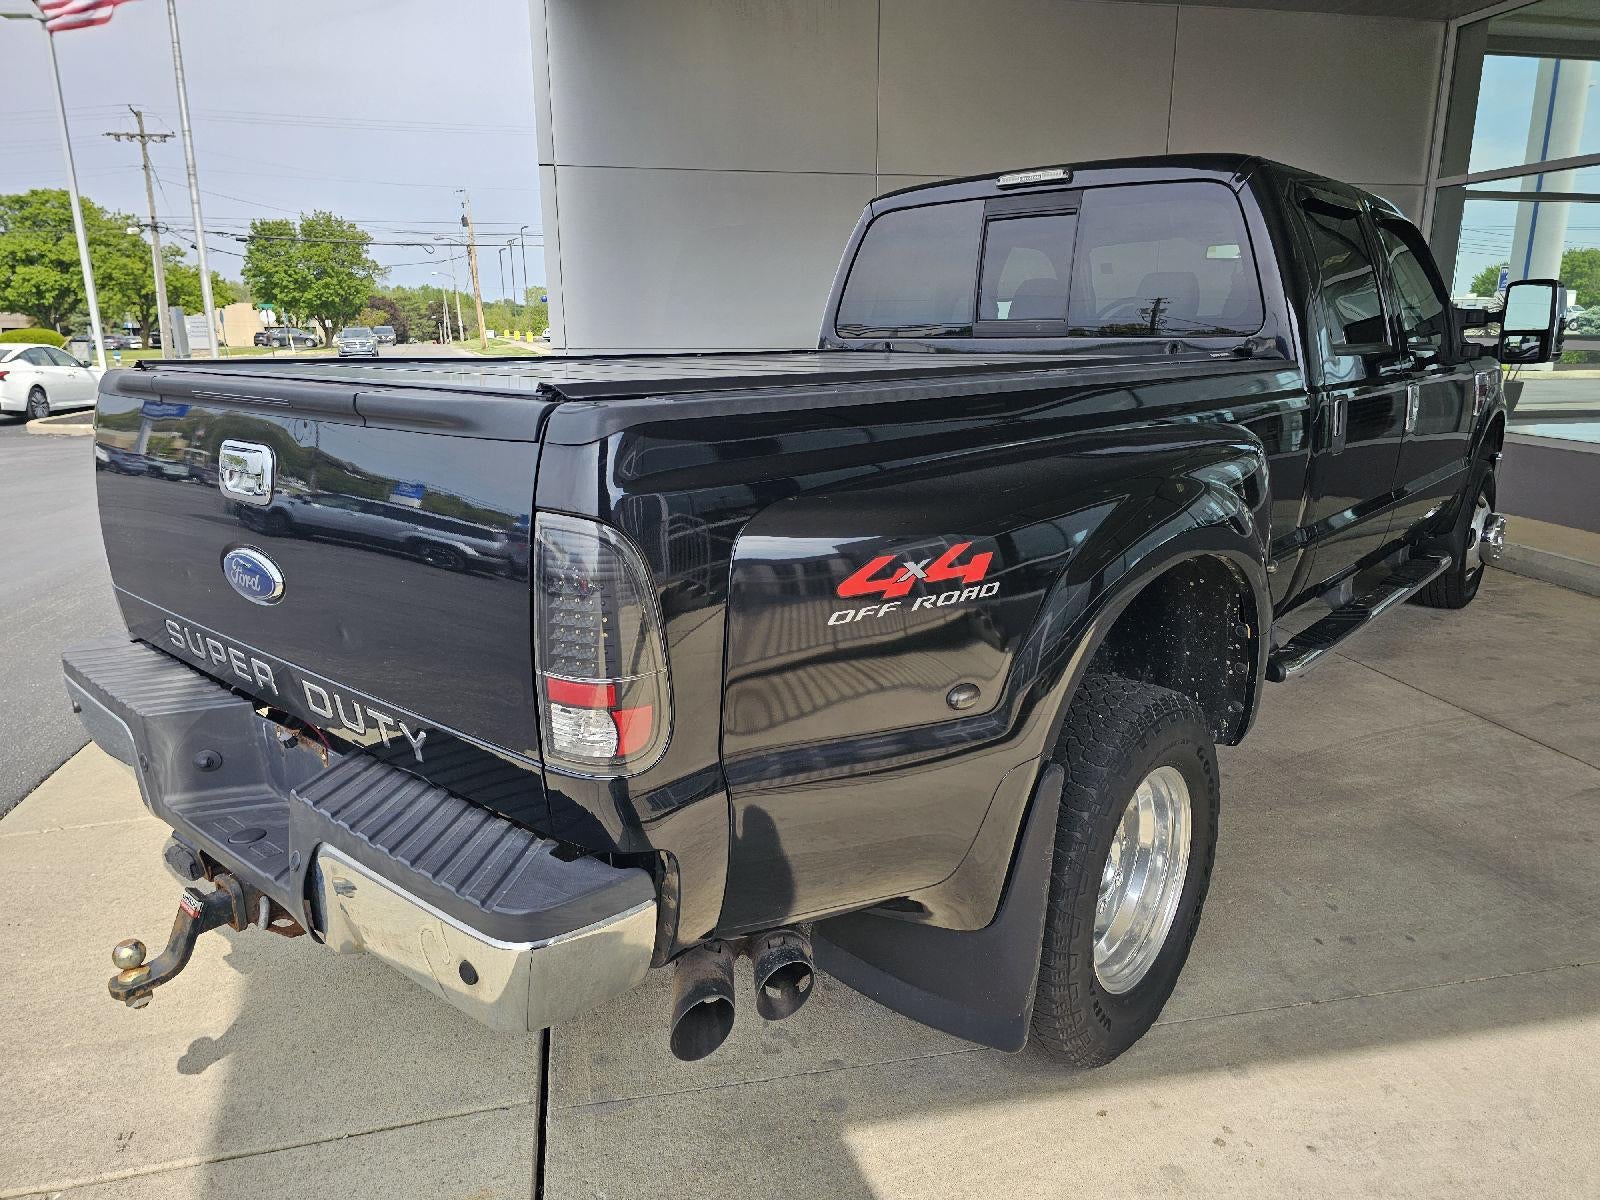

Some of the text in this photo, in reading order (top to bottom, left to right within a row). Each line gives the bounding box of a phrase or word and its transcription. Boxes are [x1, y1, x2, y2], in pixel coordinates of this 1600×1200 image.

[231, 558, 261, 591] Ford
[828, 581, 1001, 626] OFF ROAD
[165, 619, 427, 763] SUPER DUTY
